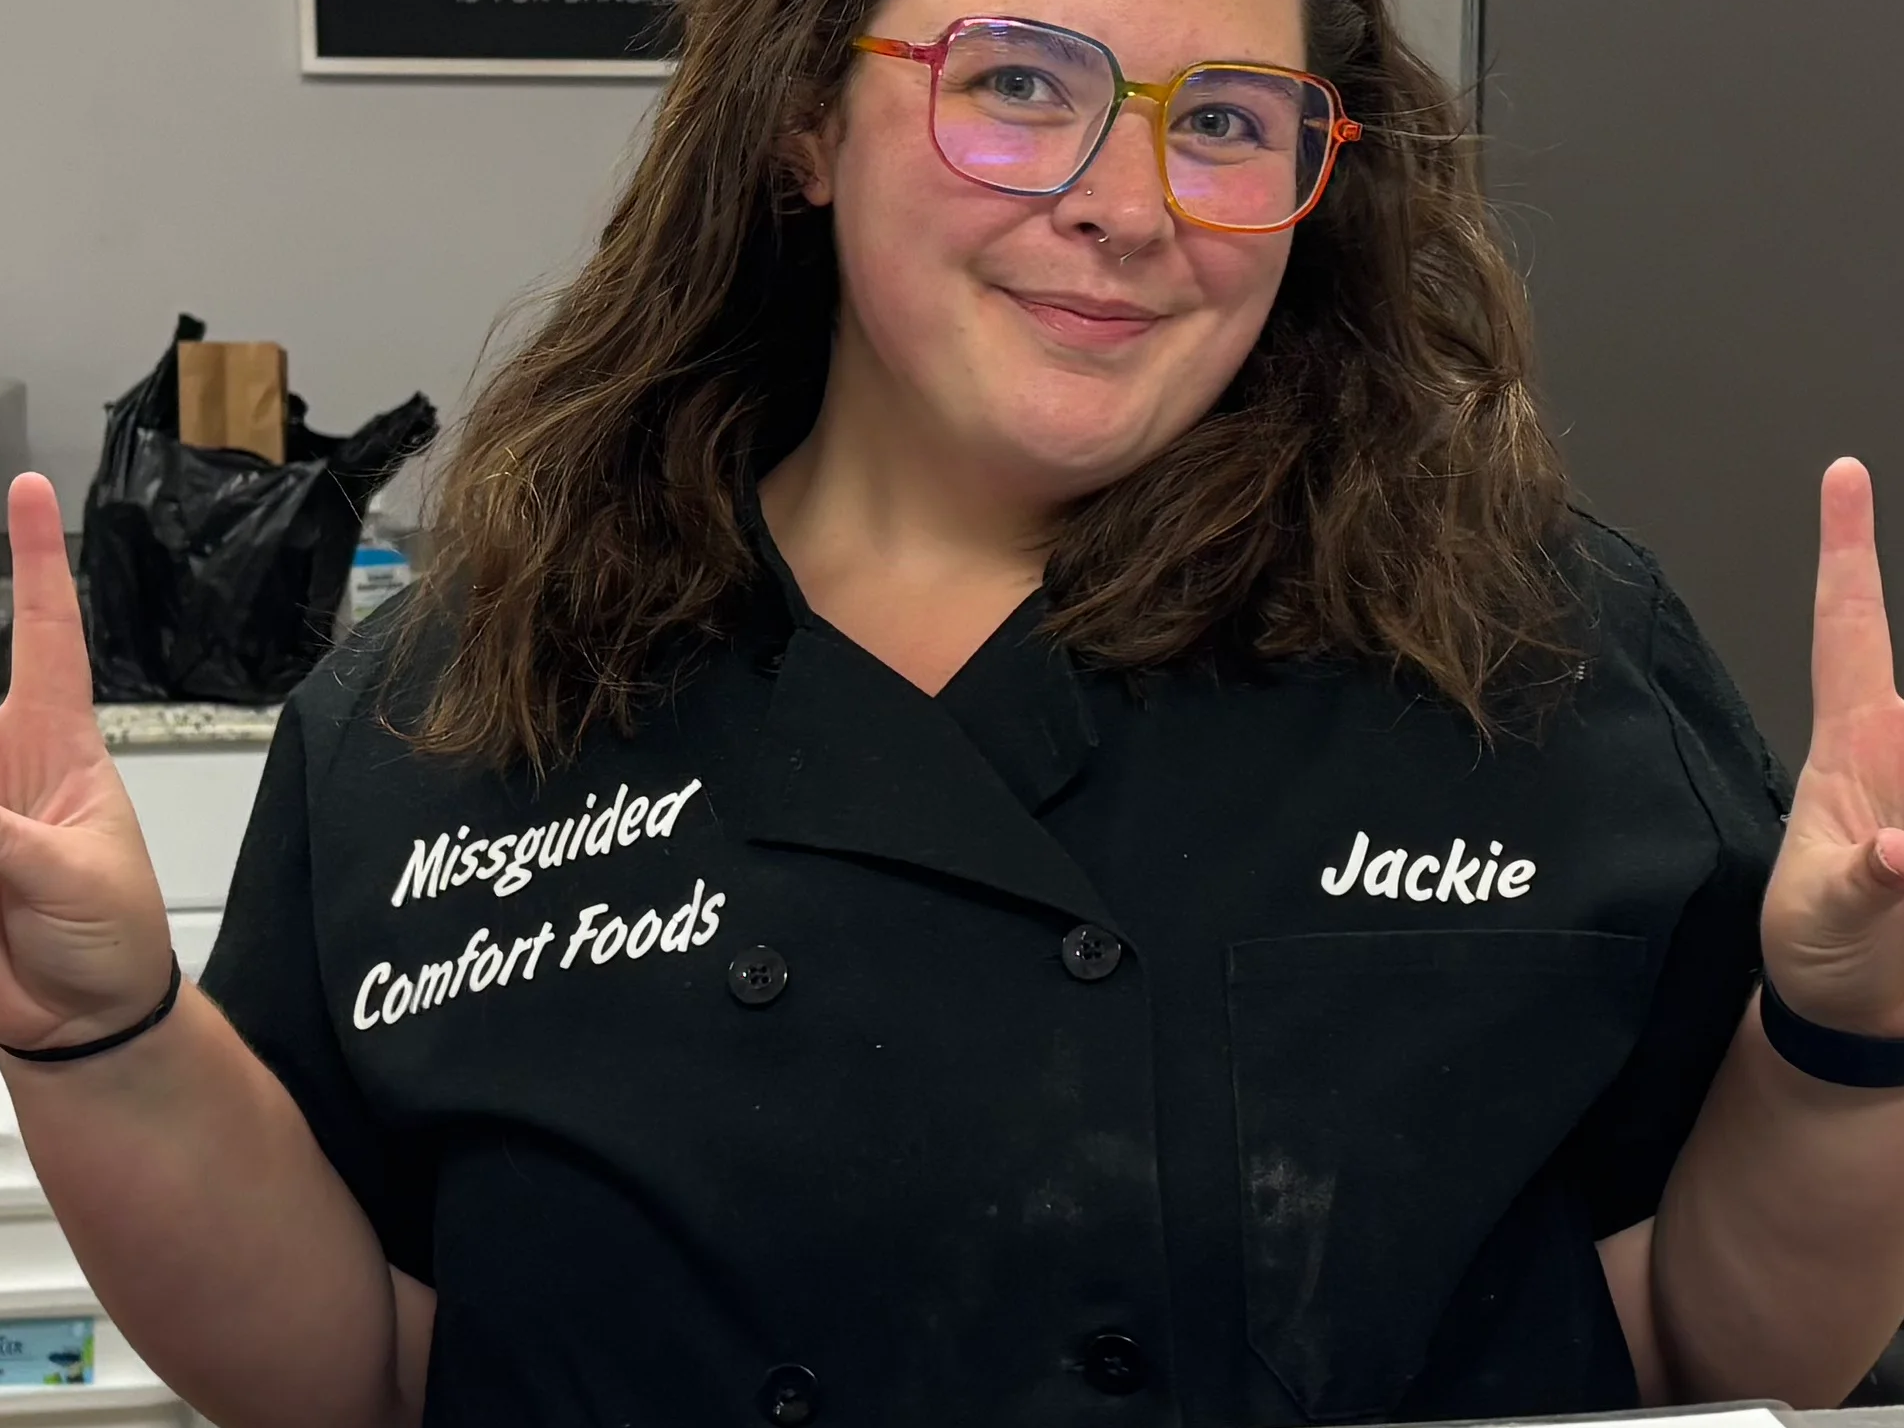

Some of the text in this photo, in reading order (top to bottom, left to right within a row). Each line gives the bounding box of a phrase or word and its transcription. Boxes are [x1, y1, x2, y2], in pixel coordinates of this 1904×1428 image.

[390, 778, 703, 908] Missguided
[1321, 831, 1536, 904] Jackie
[352, 878, 727, 1030] Comfort Foods
